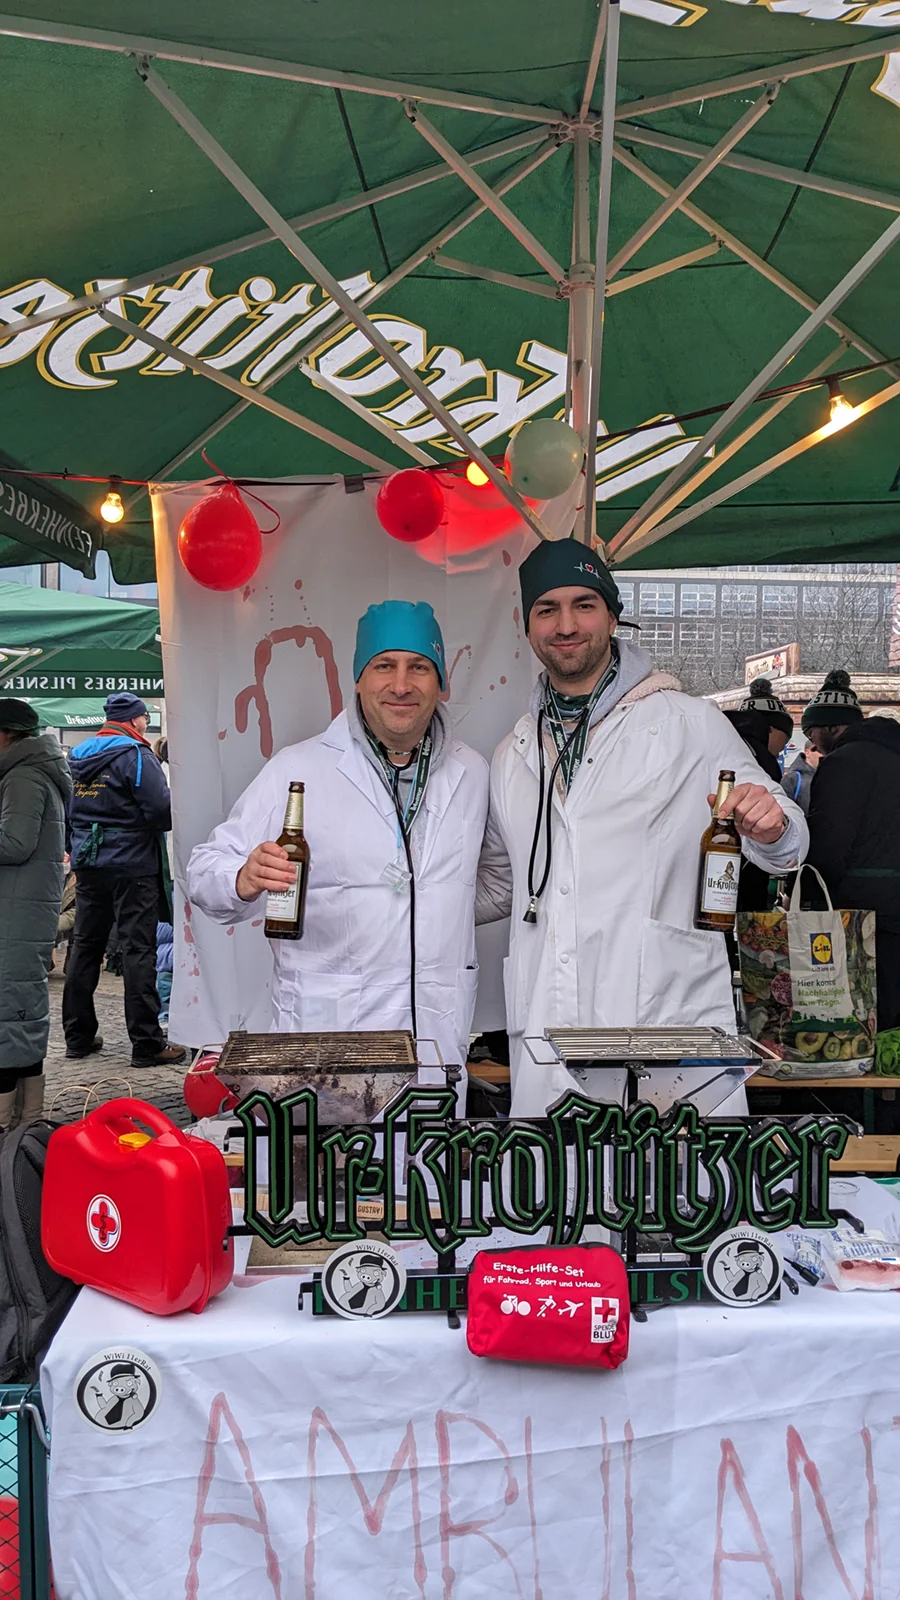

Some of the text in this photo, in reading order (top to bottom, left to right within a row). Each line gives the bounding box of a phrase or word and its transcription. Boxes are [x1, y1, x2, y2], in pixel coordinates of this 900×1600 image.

[809, 692, 859, 706] STITZ
[493, 1262, 584, 1277] Erste-Hilfe-Set
[483, 1275, 496, 1284] für
[497, 1276, 532, 1286] Fahrrad,
[535, 1277, 557, 1287] Sport
[593, 1323, 615, 1331] SPENDE
[593, 1330, 615, 1339] BLUT
